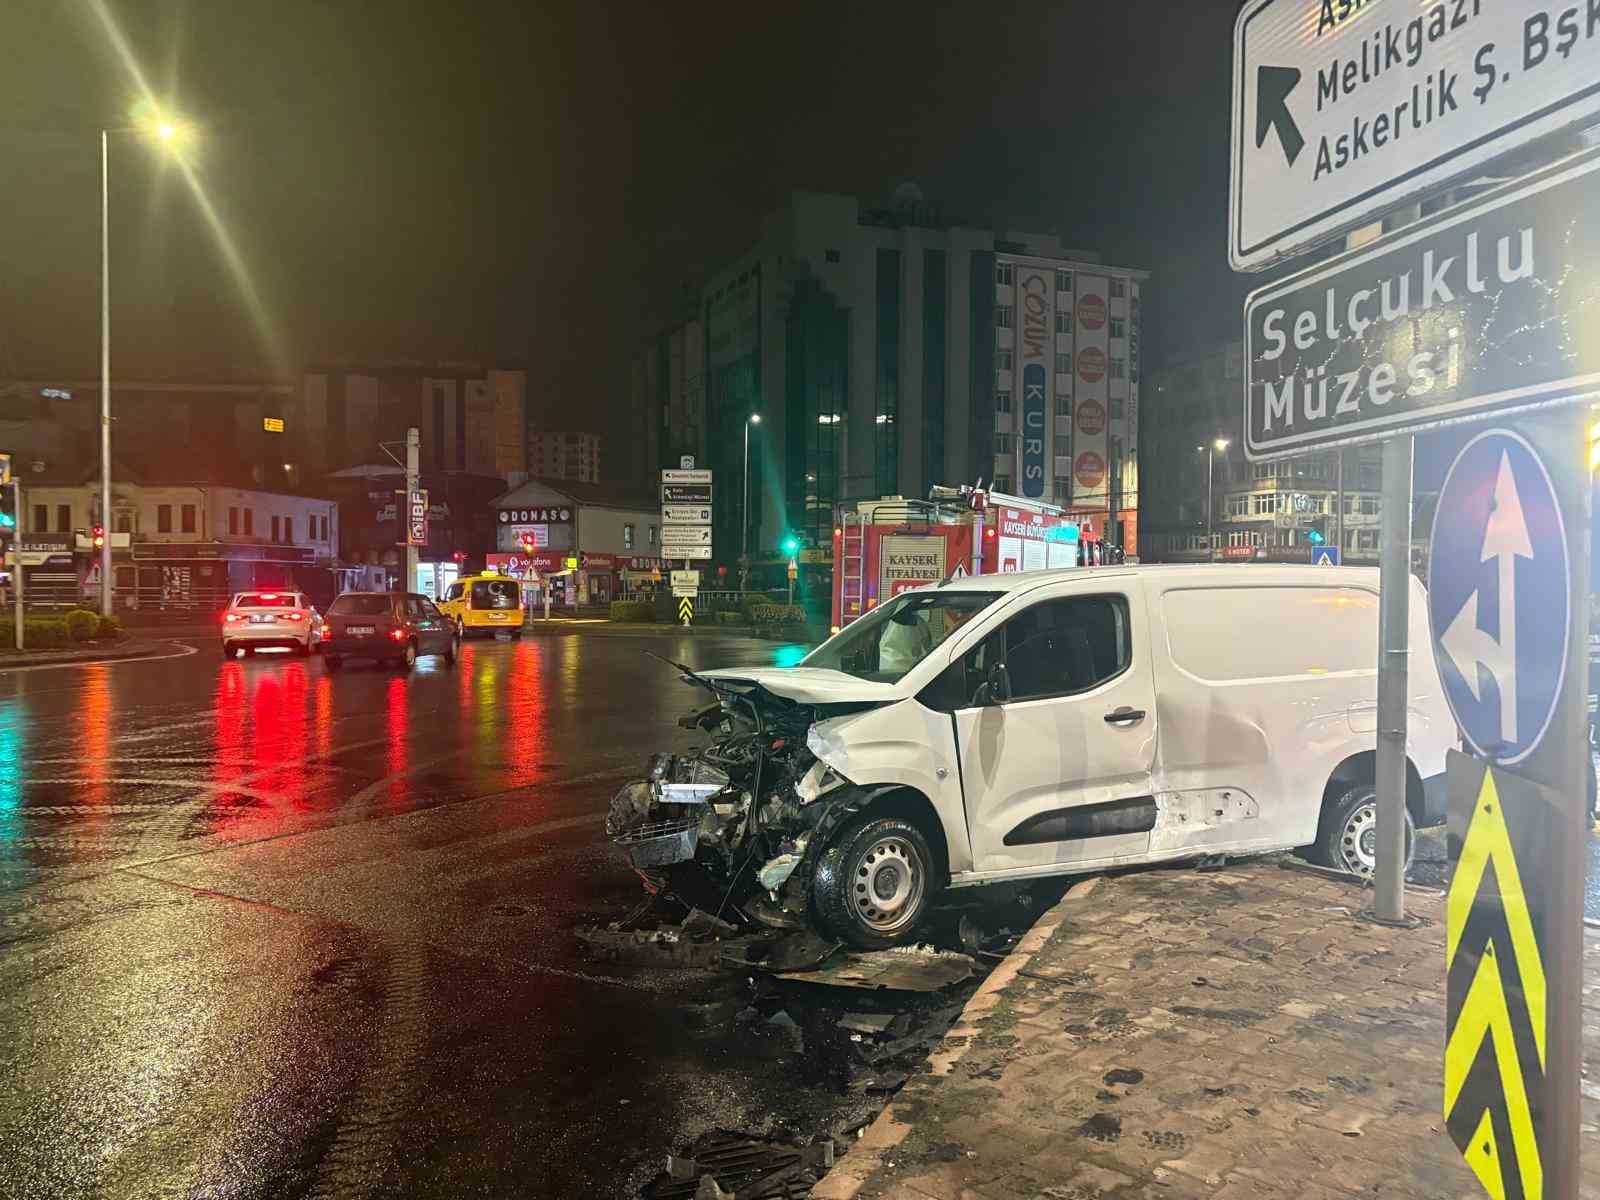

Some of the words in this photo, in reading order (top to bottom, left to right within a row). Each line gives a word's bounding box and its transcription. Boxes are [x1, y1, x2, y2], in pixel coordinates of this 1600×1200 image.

[1313, 68, 1459, 181] Askerlik
[1473, 42, 1510, 105] Ş.
[1263, 227, 1534, 361] Selçuklu
[1263, 326, 1459, 432] Müzesi
[1025, 383, 1043, 480] KURS
[886, 566, 940, 579] İTFAİYESİ
[889, 553, 938, 566] KAYSERİ
